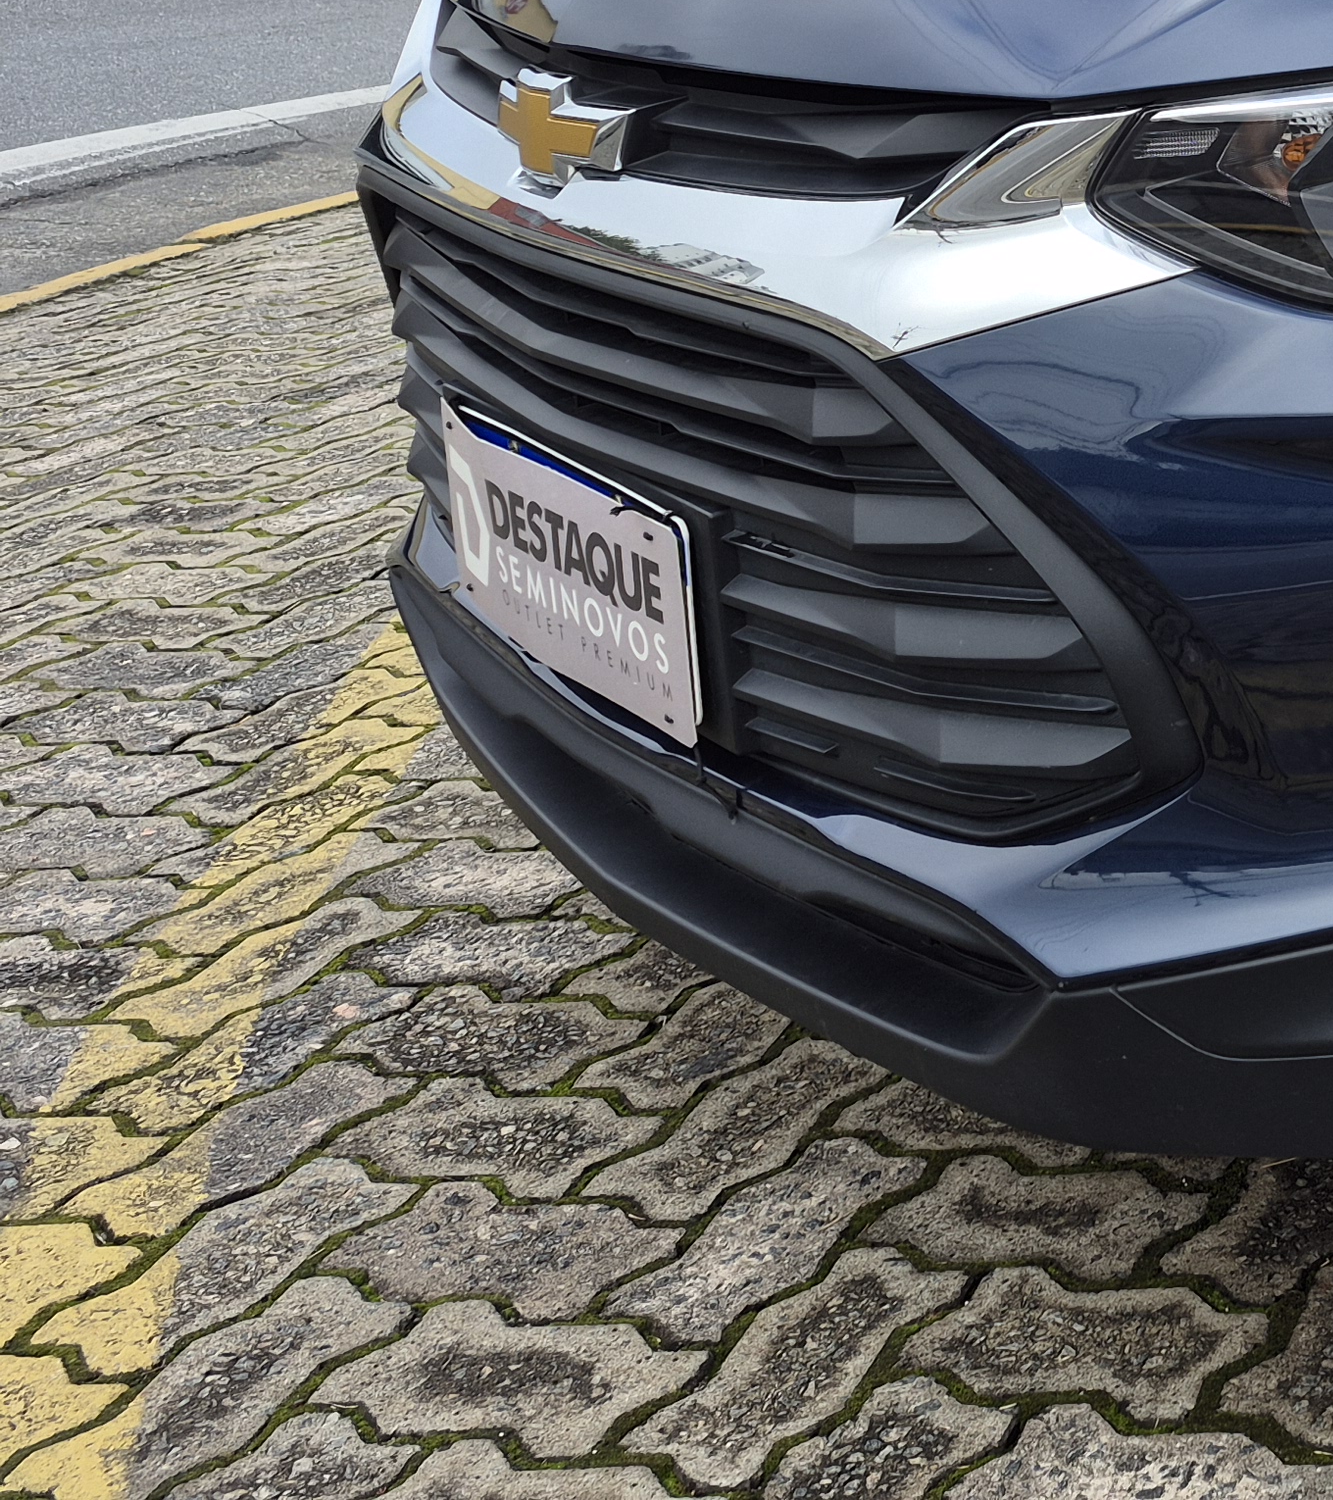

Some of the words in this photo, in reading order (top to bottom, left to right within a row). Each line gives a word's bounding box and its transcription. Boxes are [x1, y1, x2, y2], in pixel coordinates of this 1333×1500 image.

[484, 478, 665, 625] DESTAQUE
[495, 546, 670, 675] SEMINOVOS
[501, 588, 566, 642] OUTLET
[580, 636, 674, 703] PREMIUM
